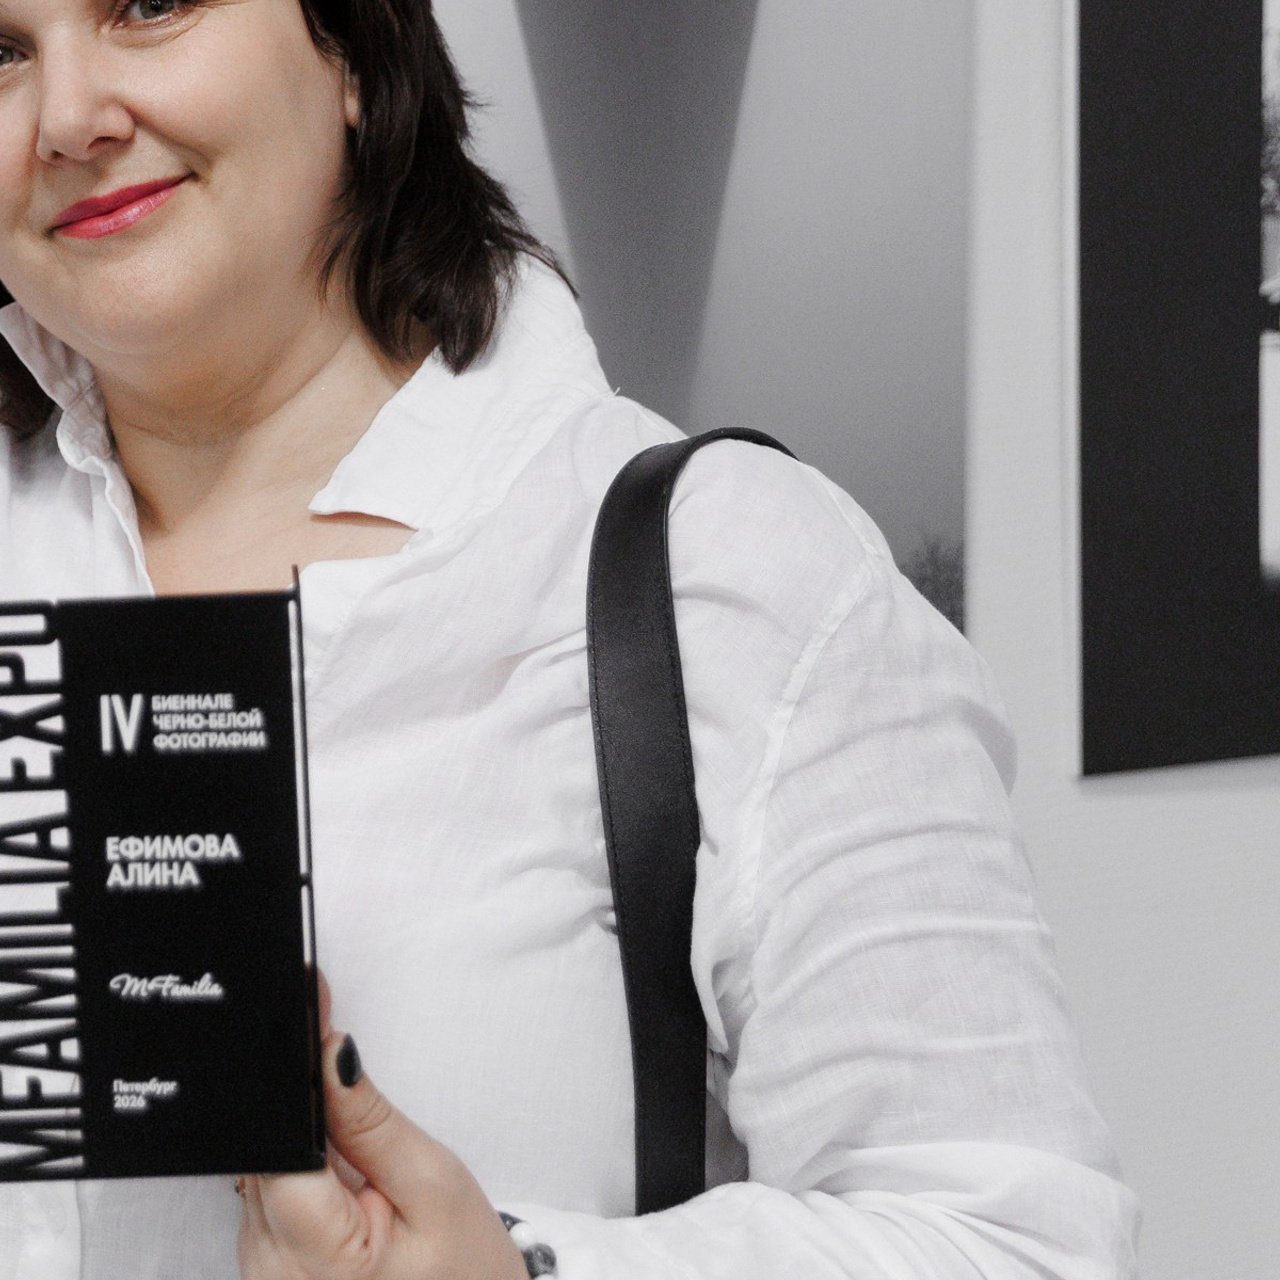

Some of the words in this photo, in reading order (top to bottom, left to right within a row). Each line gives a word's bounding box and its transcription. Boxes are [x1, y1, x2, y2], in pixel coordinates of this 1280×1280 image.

[151, 693, 234, 711] БИЕННАЛЕ
[100, 693, 144, 753] IV
[152, 707, 264, 730] ЧЕРНО-БЕЛОЙ
[152, 730, 267, 750] ФОТОГРАФИИ
[106, 833, 241, 861] ЕФИМОВА
[105, 861, 201, 888] АЛИНА
